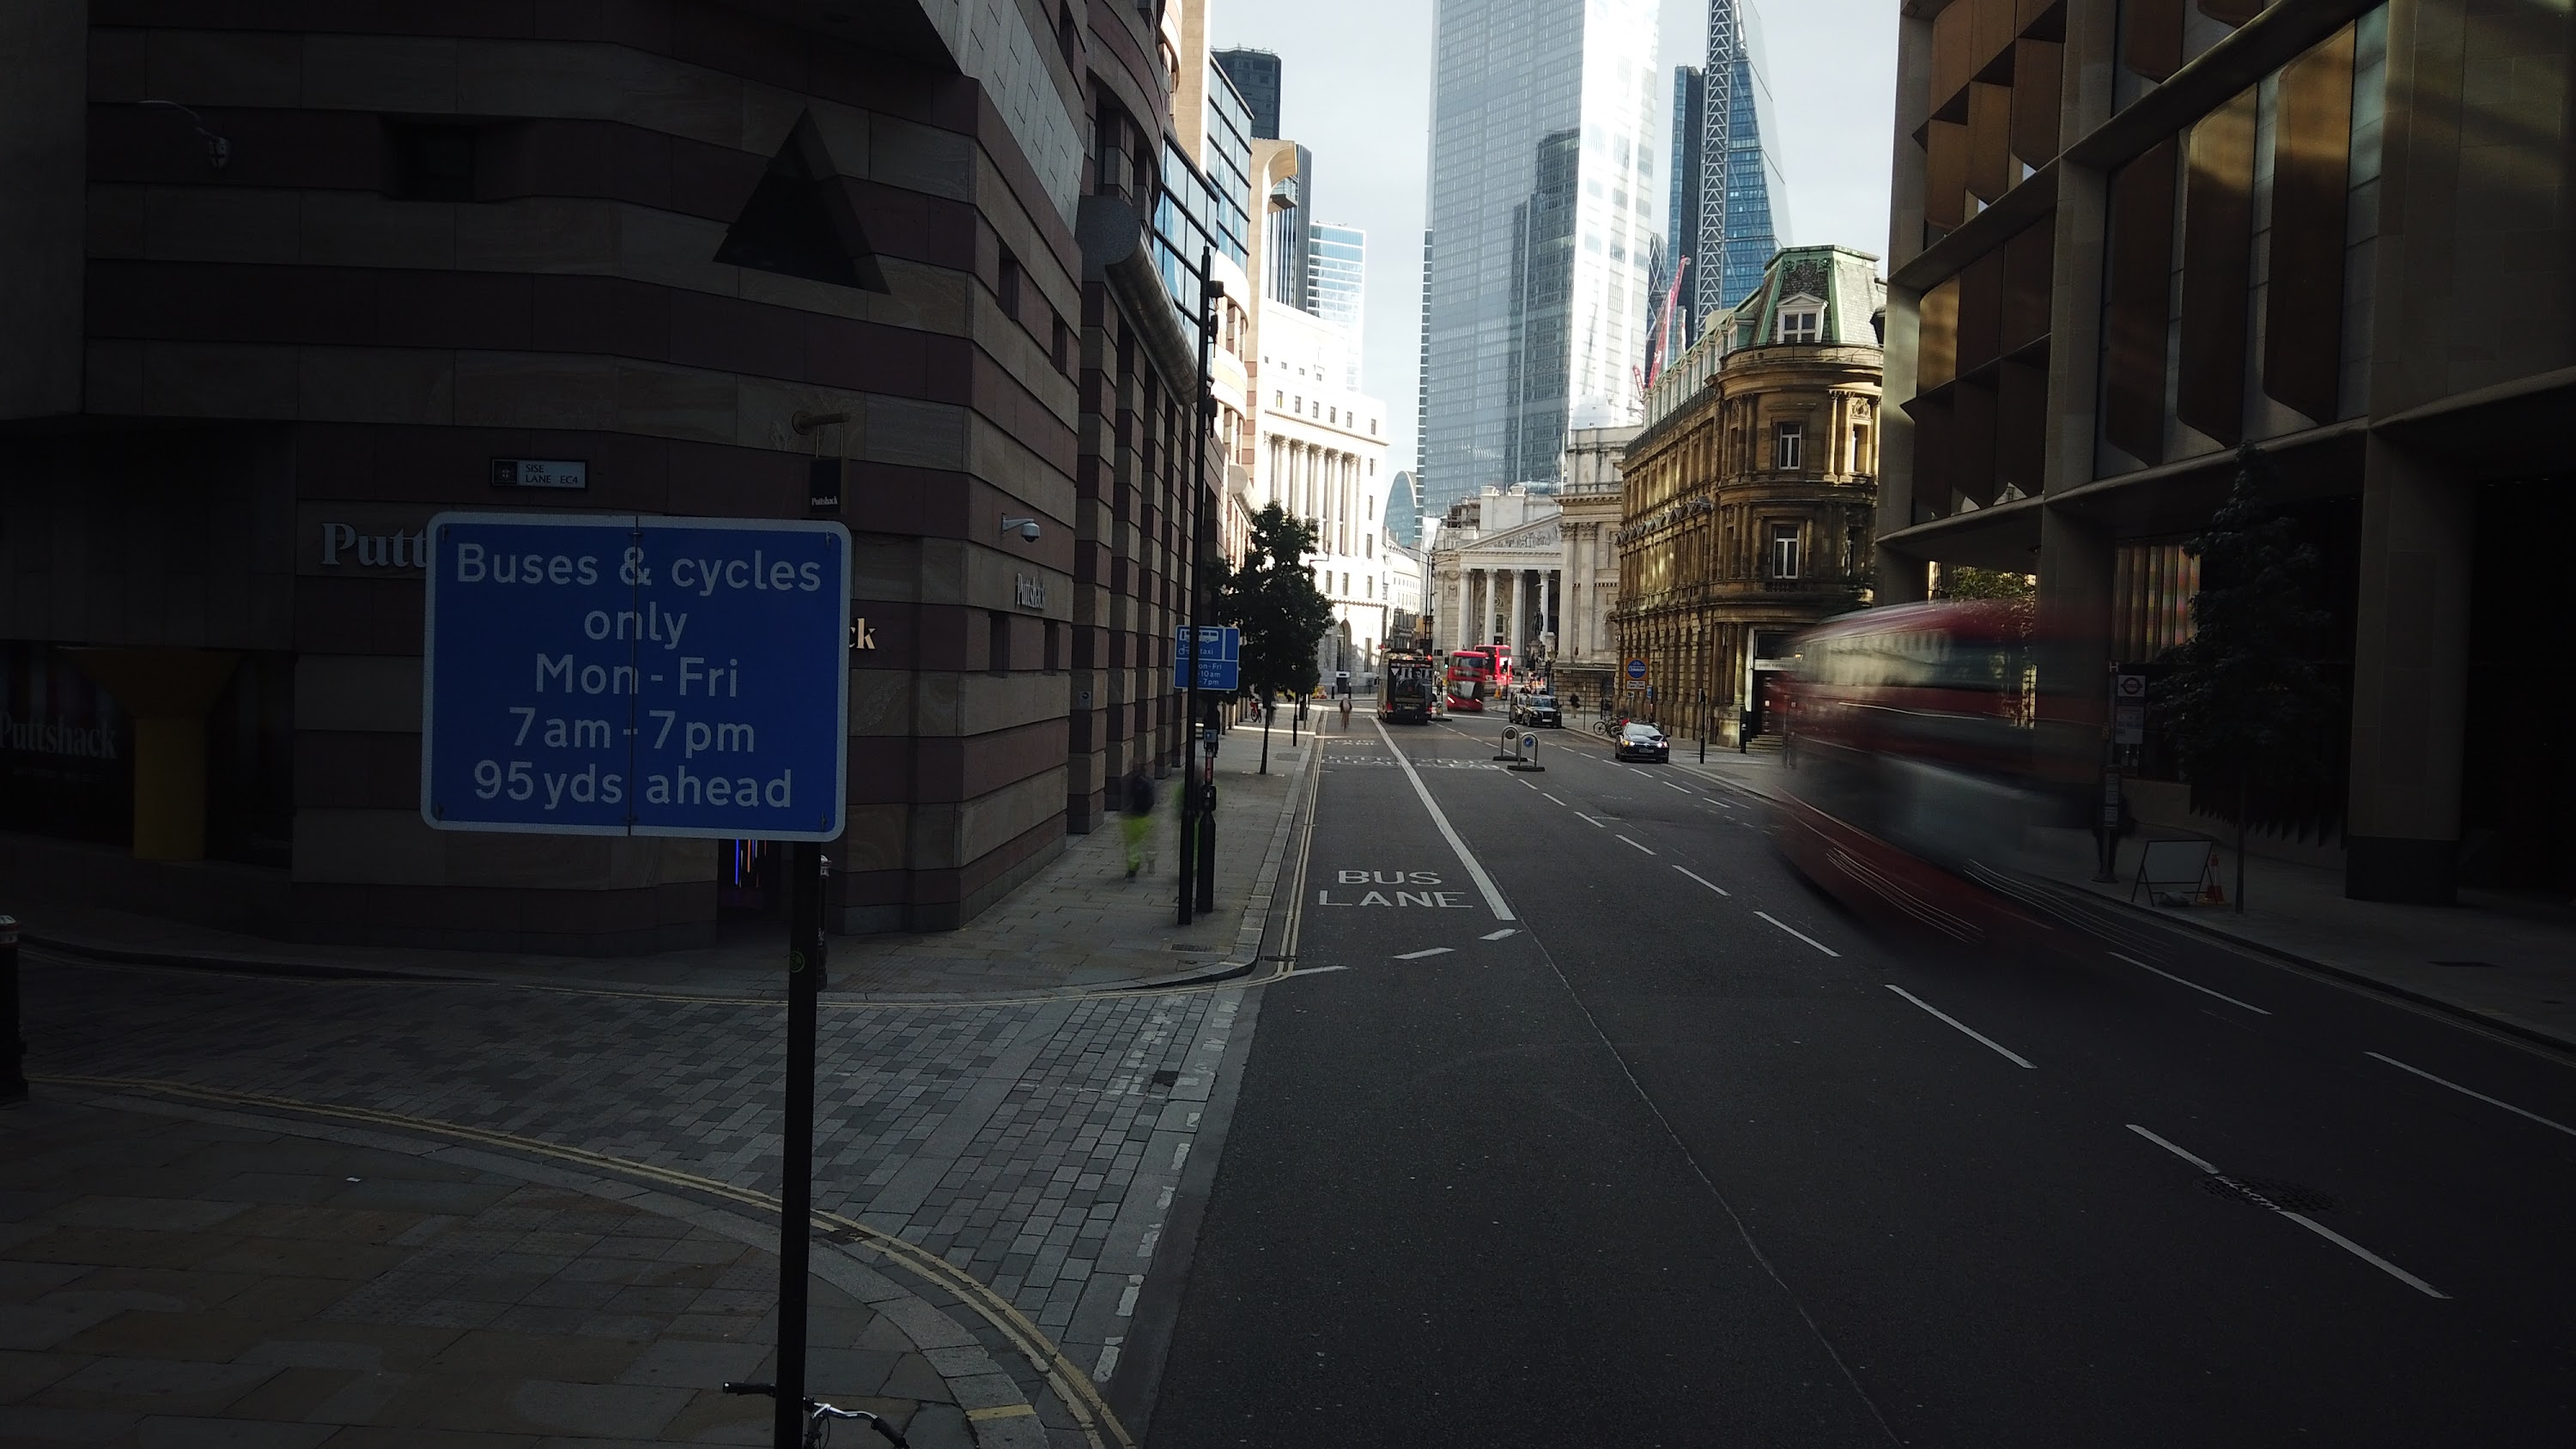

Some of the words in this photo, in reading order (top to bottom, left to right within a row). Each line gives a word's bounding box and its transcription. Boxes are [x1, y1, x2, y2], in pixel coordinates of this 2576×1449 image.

[526, 464, 544, 473] SISE
[526, 475, 551, 483] LANE
[457, 543, 598, 585] Buses
[619, 546, 653, 586] &
[671, 549, 822, 597] cycles
[584, 601, 688, 650] only
[646, 765, 793, 809] ahead
[1338, 870, 1443, 885] BUS
[1319, 889, 1474, 908] LANE
